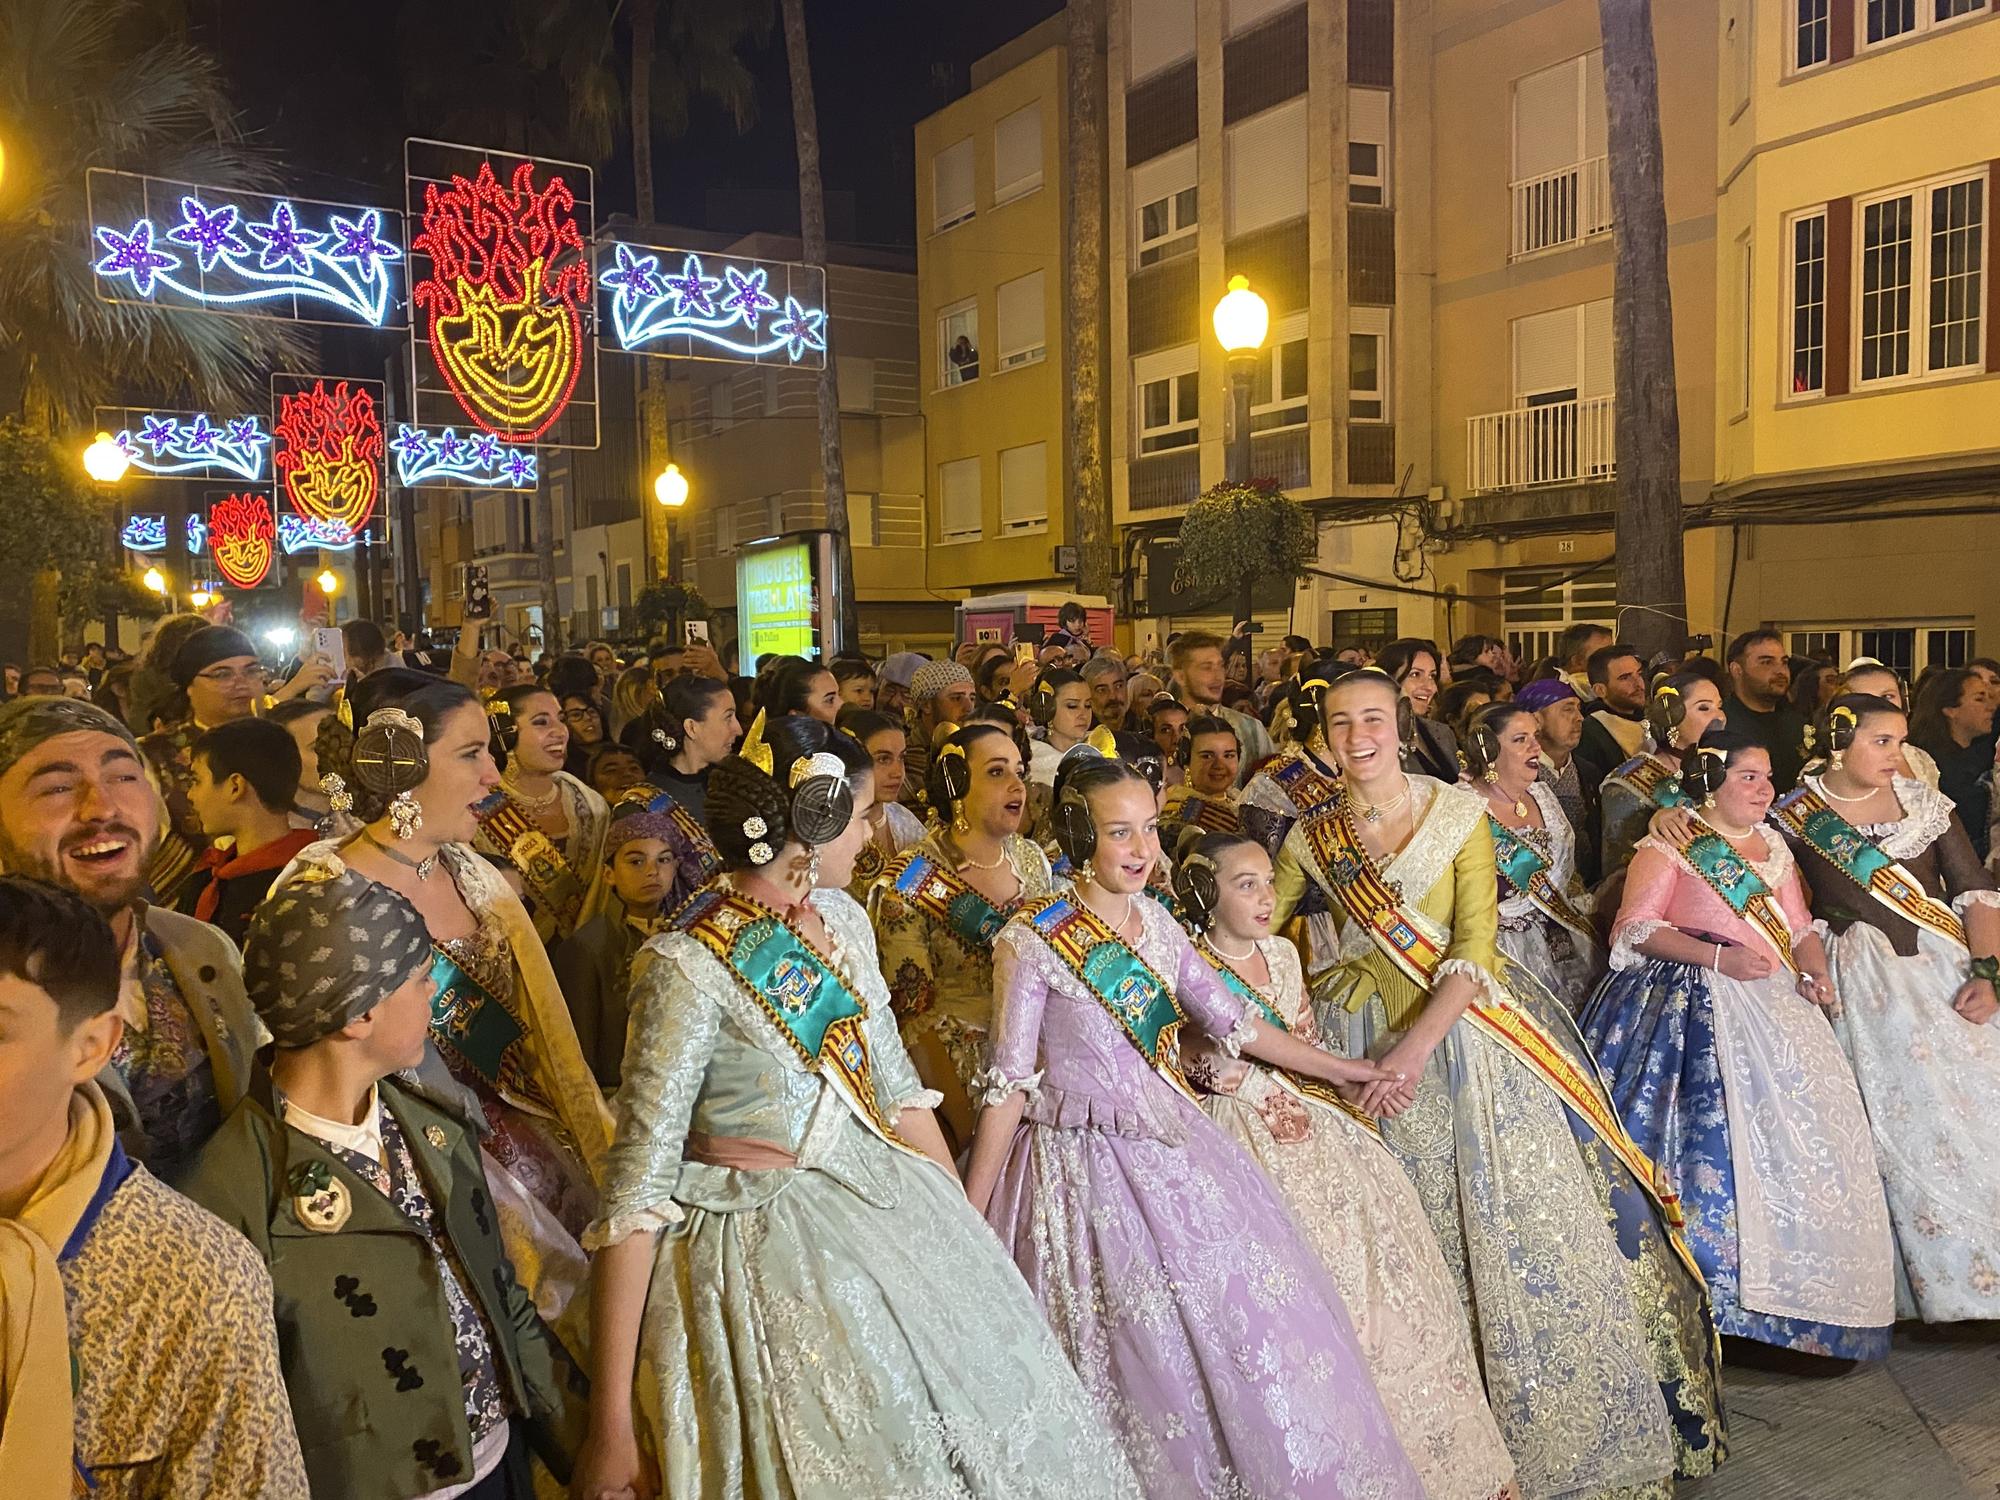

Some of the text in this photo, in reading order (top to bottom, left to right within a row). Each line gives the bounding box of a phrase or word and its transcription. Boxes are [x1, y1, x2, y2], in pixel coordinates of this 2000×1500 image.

[1561, 543, 1571, 551] 28
[1808, 814, 1831, 836] 2023
[518, 838, 537, 855] 2023
[733, 923, 773, 962] 2023
[1089, 947, 1120, 977] 2023
